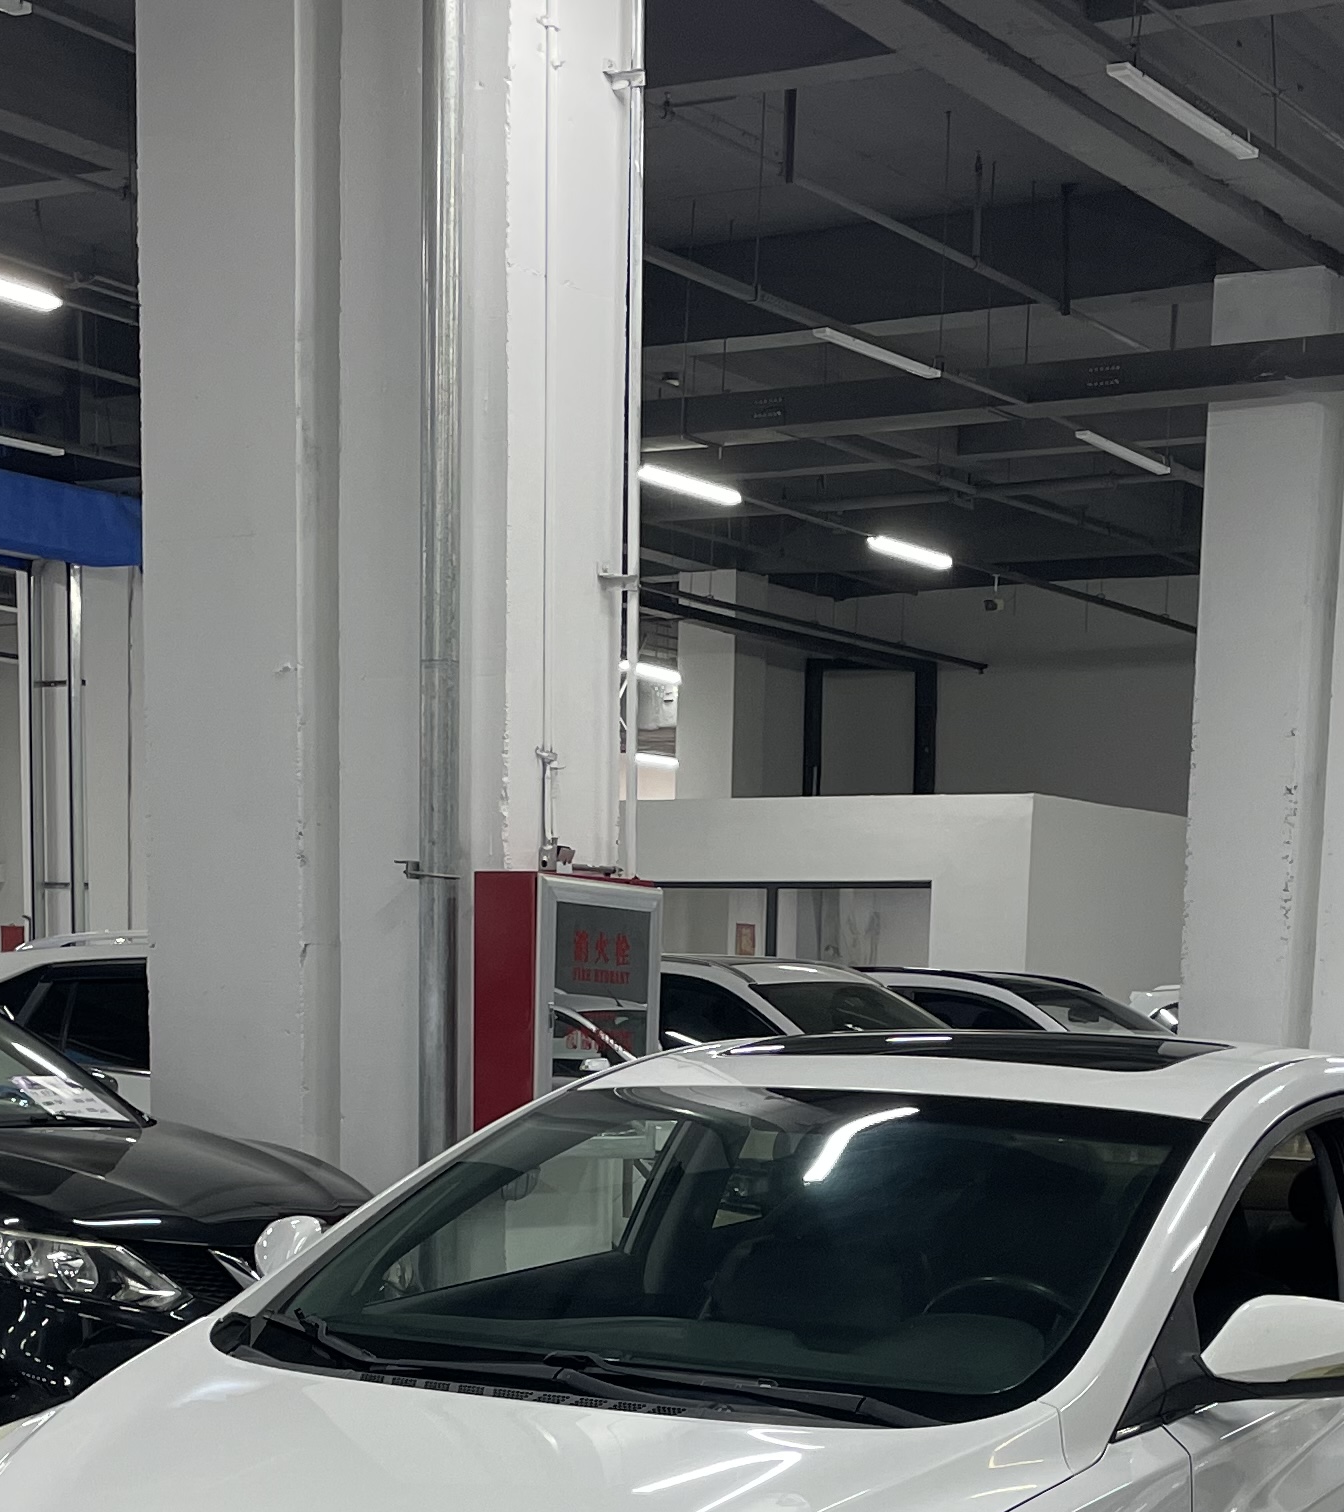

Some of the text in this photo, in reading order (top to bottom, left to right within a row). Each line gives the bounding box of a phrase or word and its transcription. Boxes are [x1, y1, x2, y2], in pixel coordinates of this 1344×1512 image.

[572, 930, 631, 966] 消火栓
[573, 967, 592, 982] FIRE
